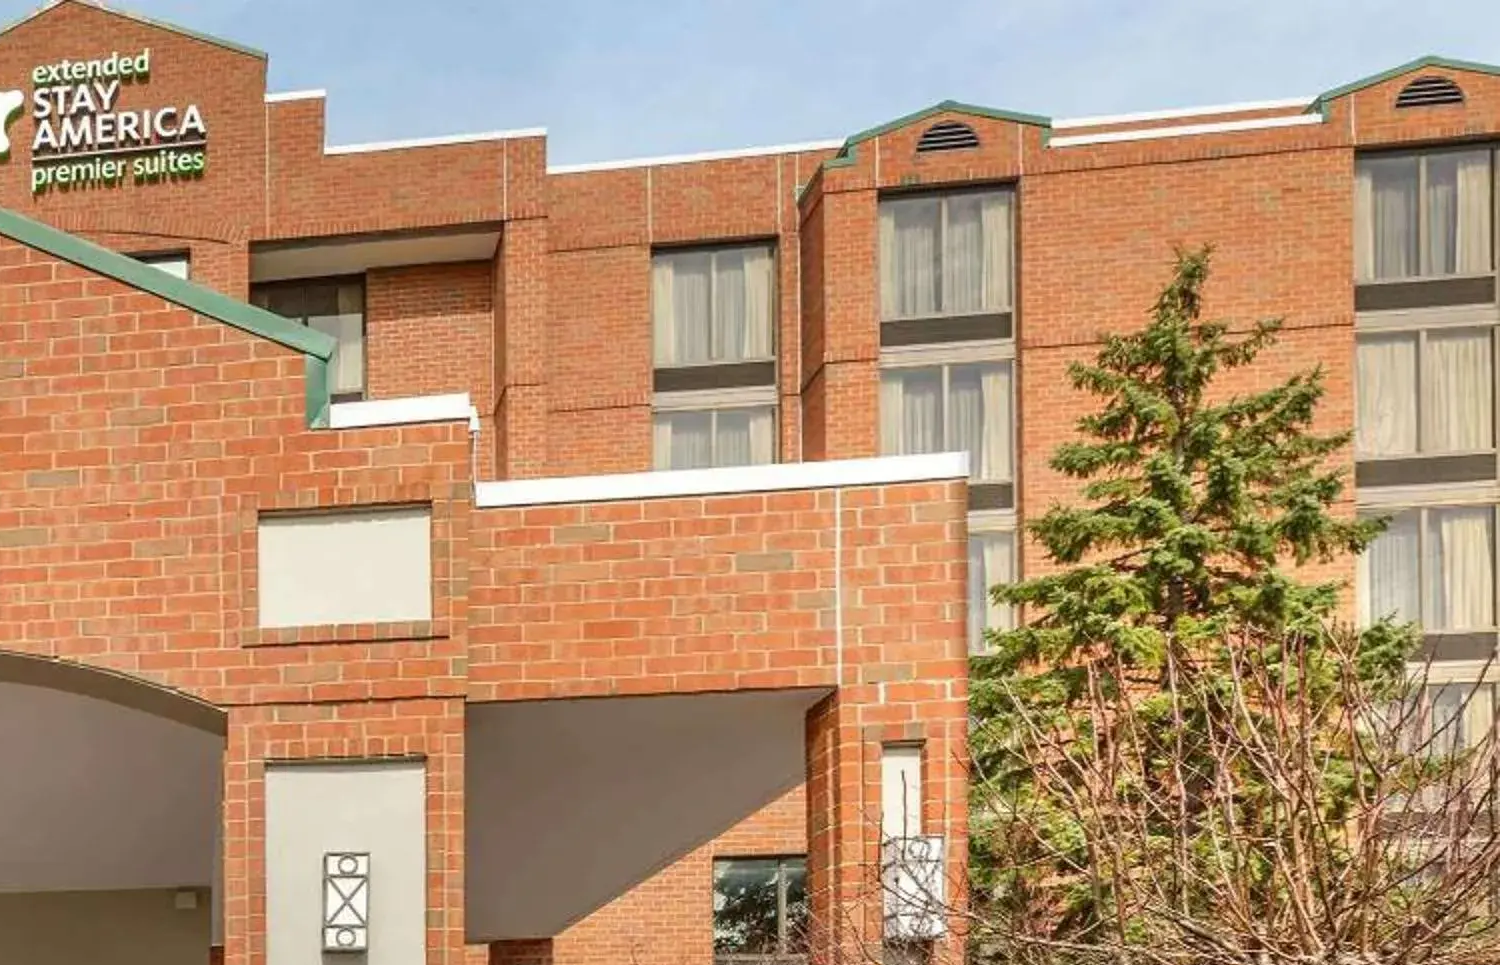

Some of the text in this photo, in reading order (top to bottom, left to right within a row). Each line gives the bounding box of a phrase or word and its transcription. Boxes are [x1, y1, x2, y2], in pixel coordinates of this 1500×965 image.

[32, 48, 149, 83] extended
[32, 80, 119, 118] STAY
[32, 104, 206, 149] AMERICA
[32, 150, 205, 191] premier suites
